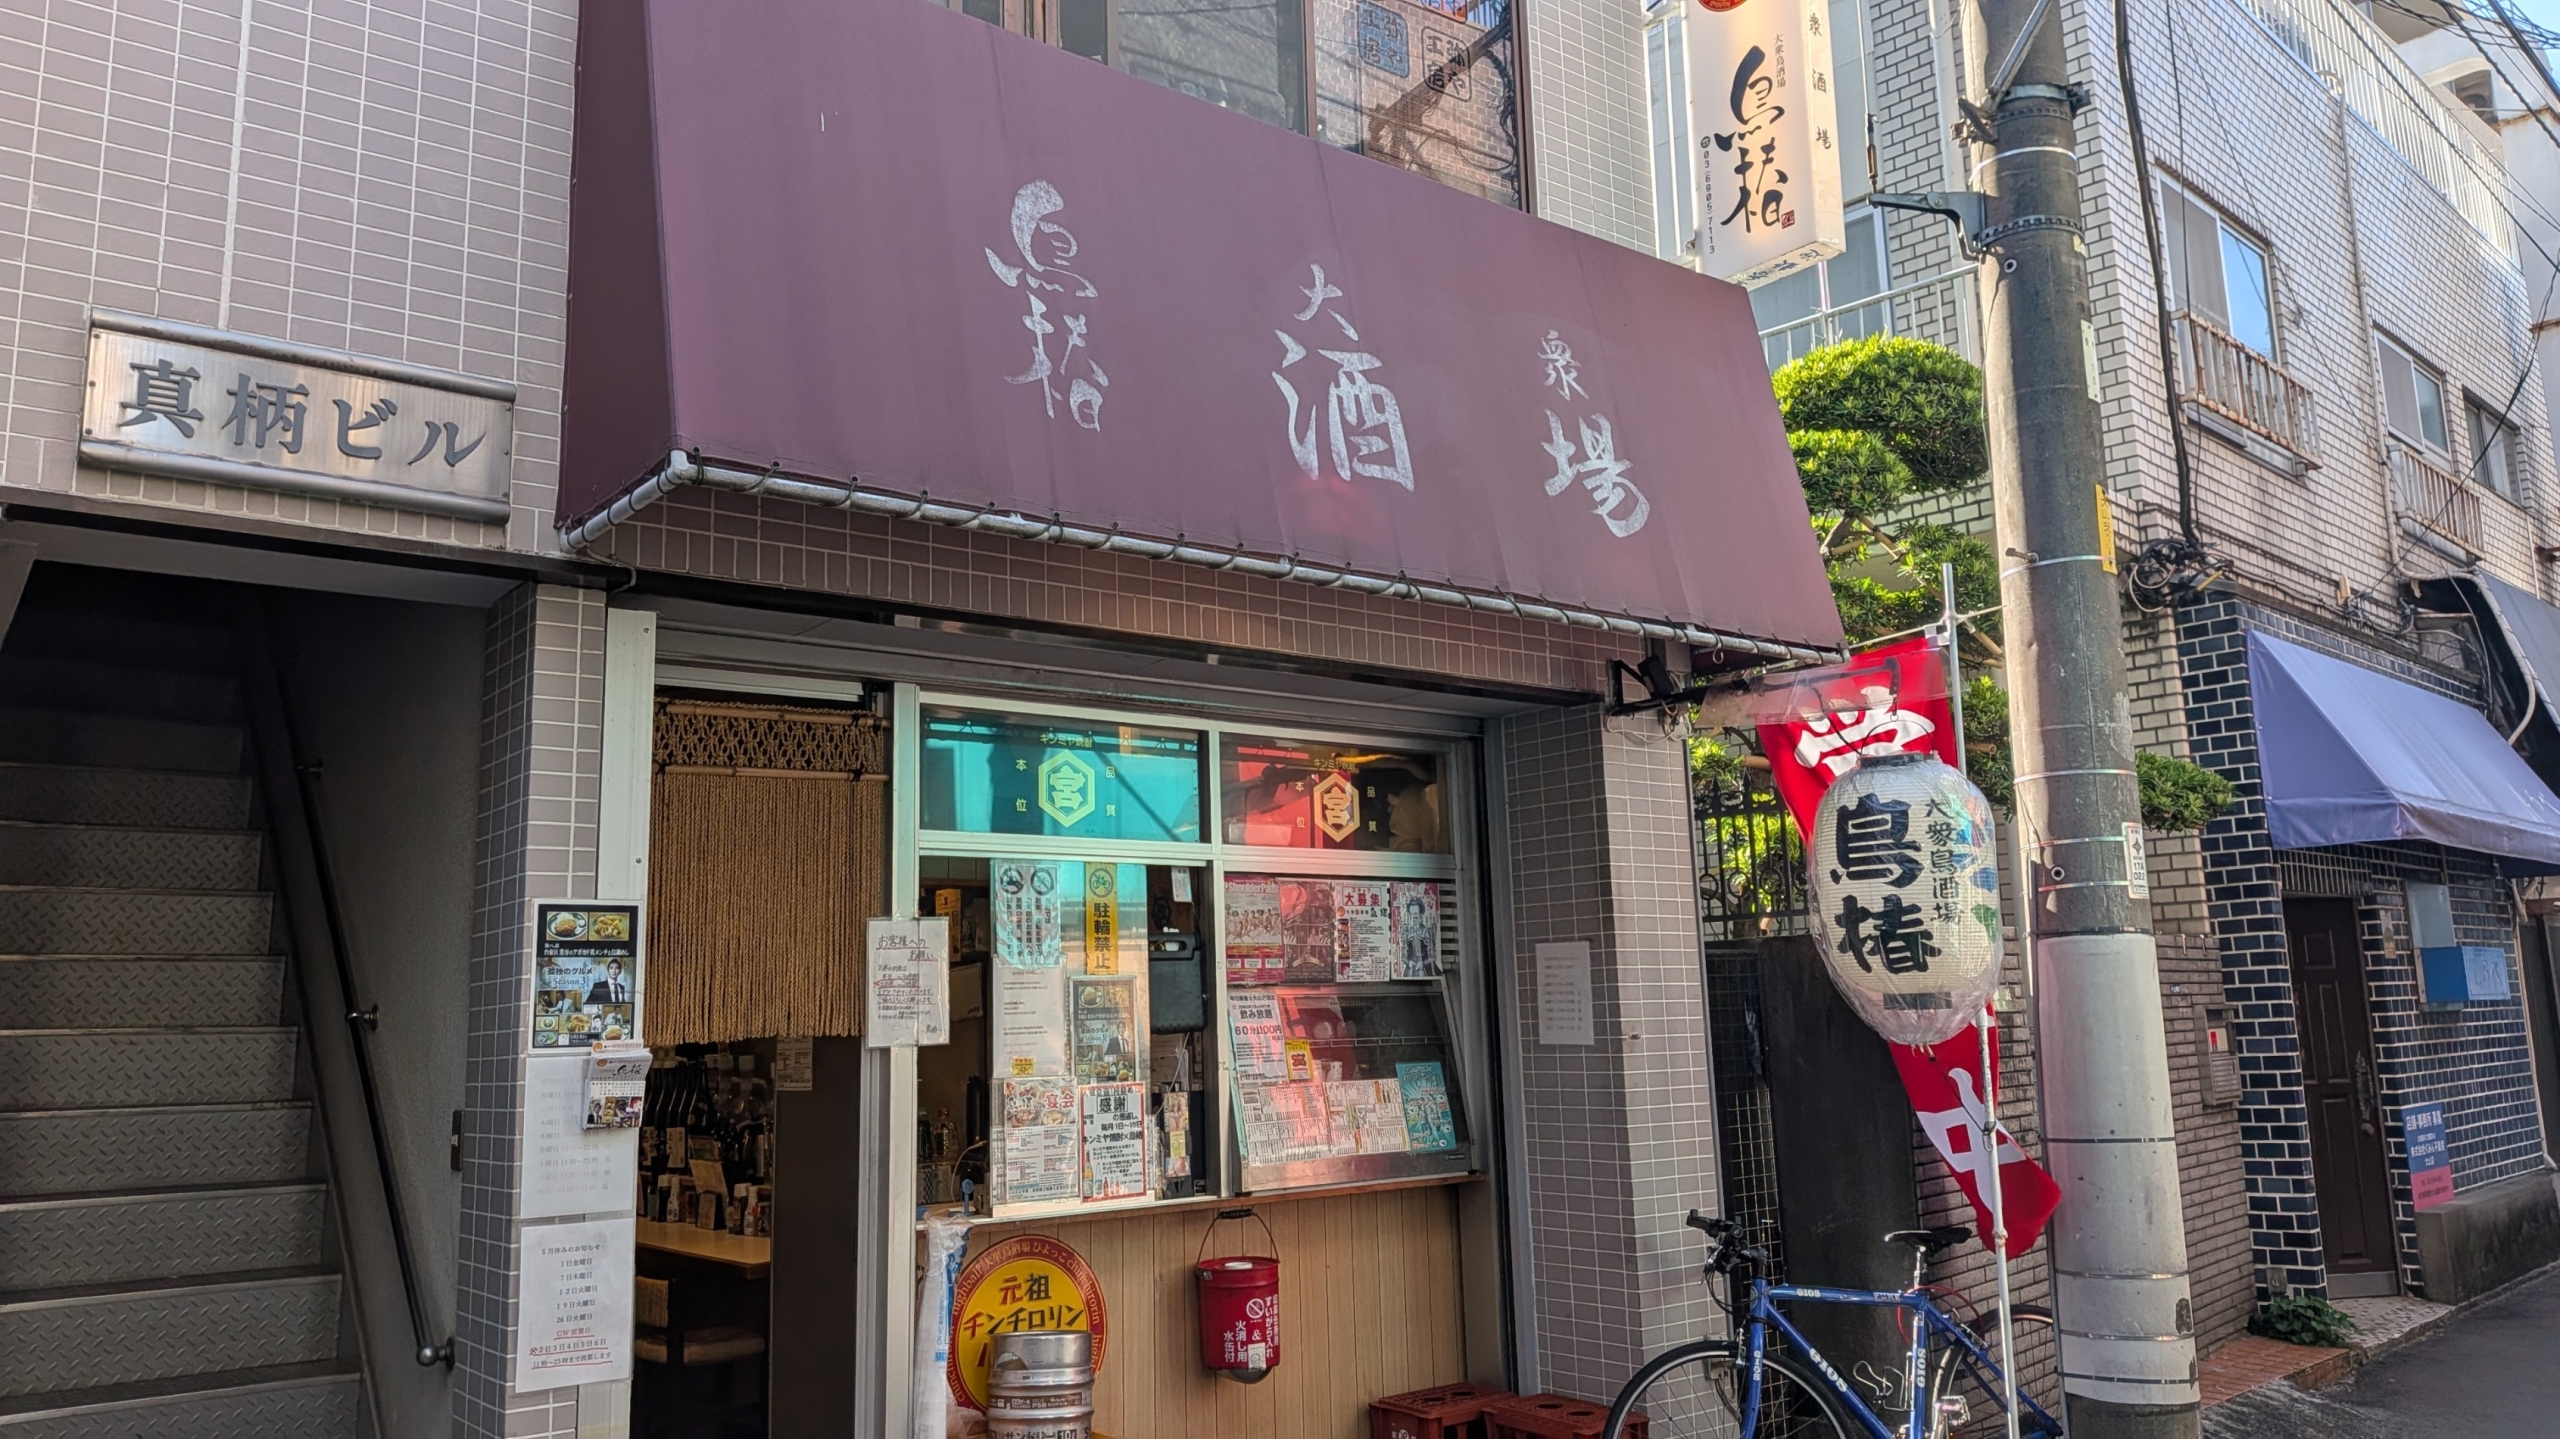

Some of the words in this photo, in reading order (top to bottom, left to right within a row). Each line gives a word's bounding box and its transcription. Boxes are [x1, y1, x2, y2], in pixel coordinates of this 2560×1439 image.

[1773, 33, 1787, 89] 大衆鳥酒場
[119, 358, 487, 468] 真柄ビル
[1923, 797, 1964, 927] 大衆鳥酒場
[1830, 791, 1943, 975] 鳥椿
[1093, 902, 1111, 970] 駐輪禁止
[1234, 1024, 1283, 1036] 60分1100円
[1239, 1008, 1274, 1020] 飲み放題
[1099, 1095, 1126, 1113] 感謝
[999, 1273, 1052, 1306] 元祖
[1796, 1288, 1821, 1298] GIOS
[962, 1304, 1085, 1340] チンチロリン
[1235, 1320, 1248, 1363] 火消し用
[1264, 1295, 1275, 1358] すいがら入れ
[1223, 1330, 1236, 1363] 水缶付
[1752, 1350, 1762, 1382] GIOS
[1809, 1348, 1848, 1393] GIOS
[1916, 1348, 1926, 1388] GIOS
